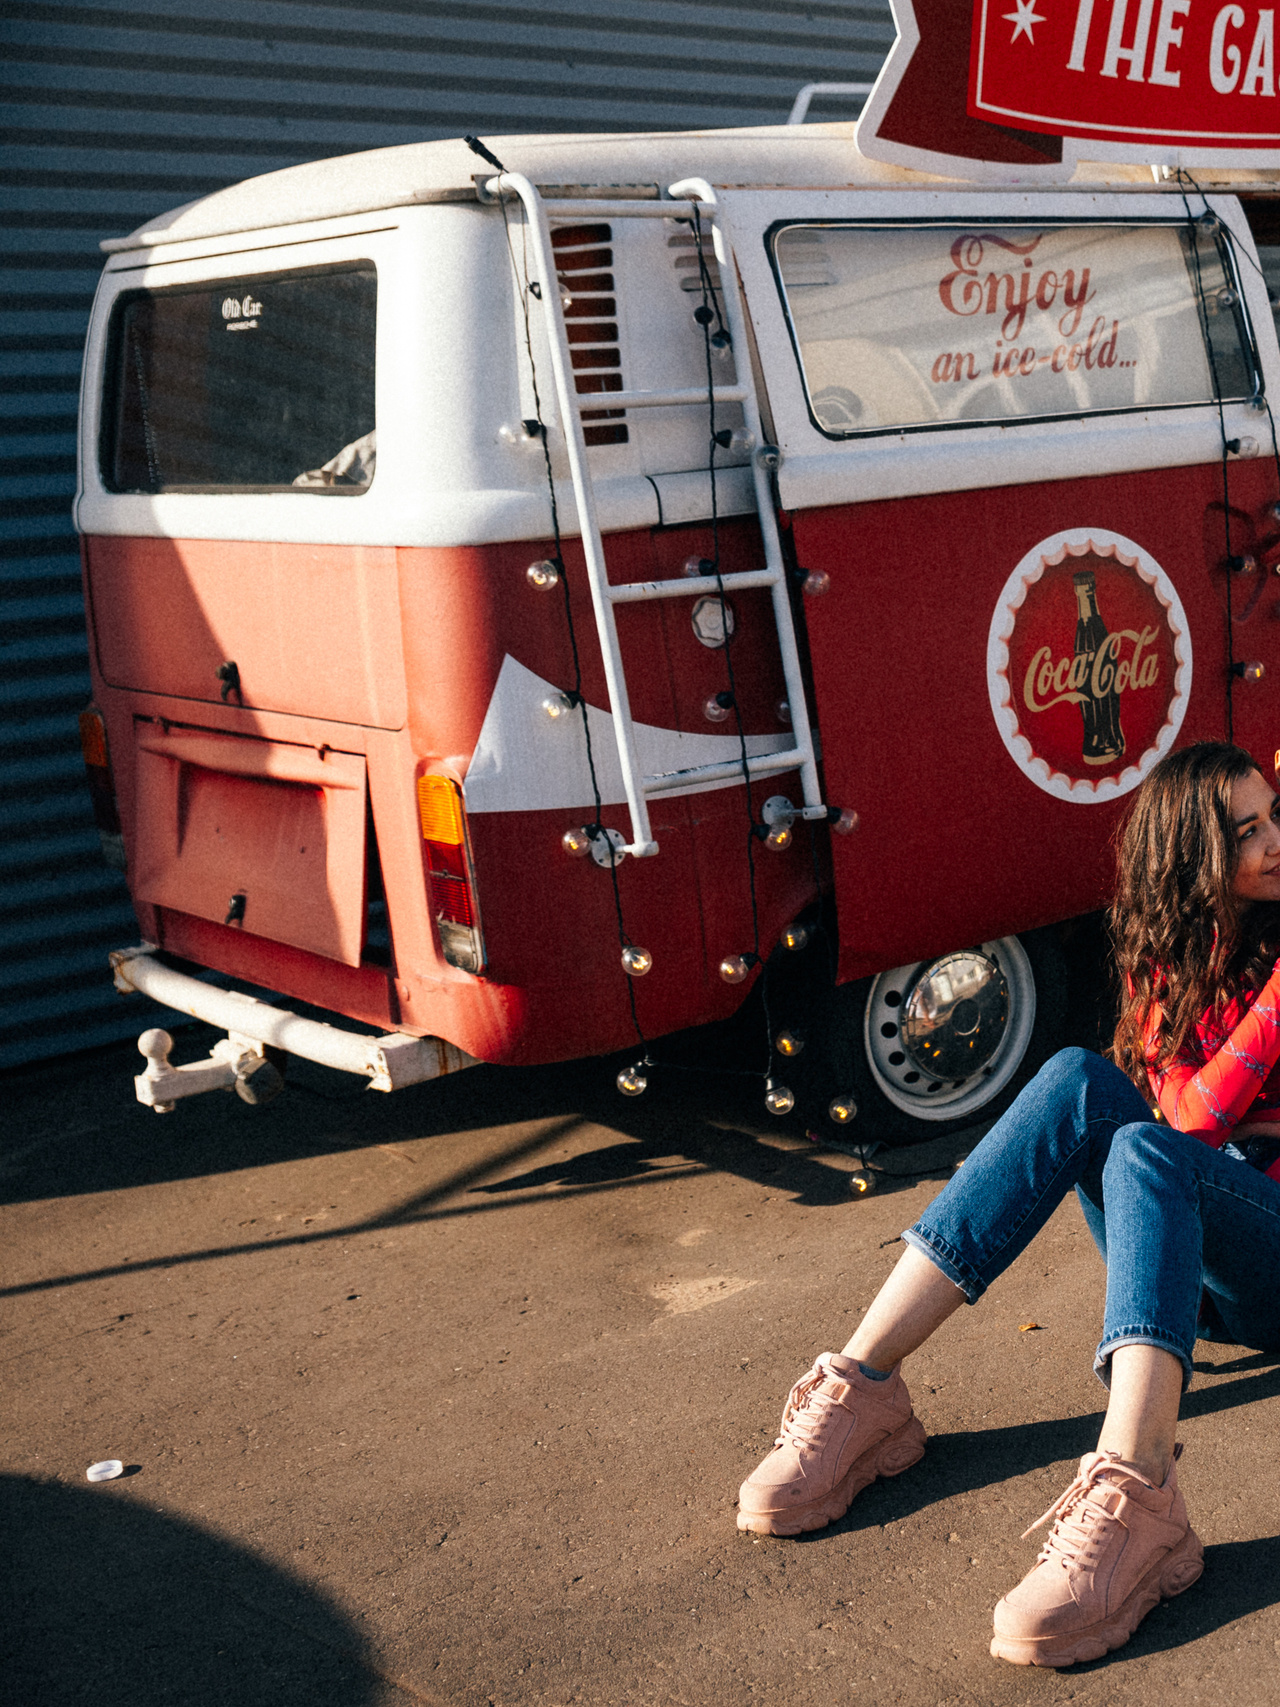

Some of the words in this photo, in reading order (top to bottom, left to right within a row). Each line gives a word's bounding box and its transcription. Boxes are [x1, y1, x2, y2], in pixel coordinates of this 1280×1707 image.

[222, 297, 241, 320] Old
[939, 233, 1097, 341] Enjoy
[931, 350, 980, 383] an
[992, 315, 1137, 379] ice-cold...
